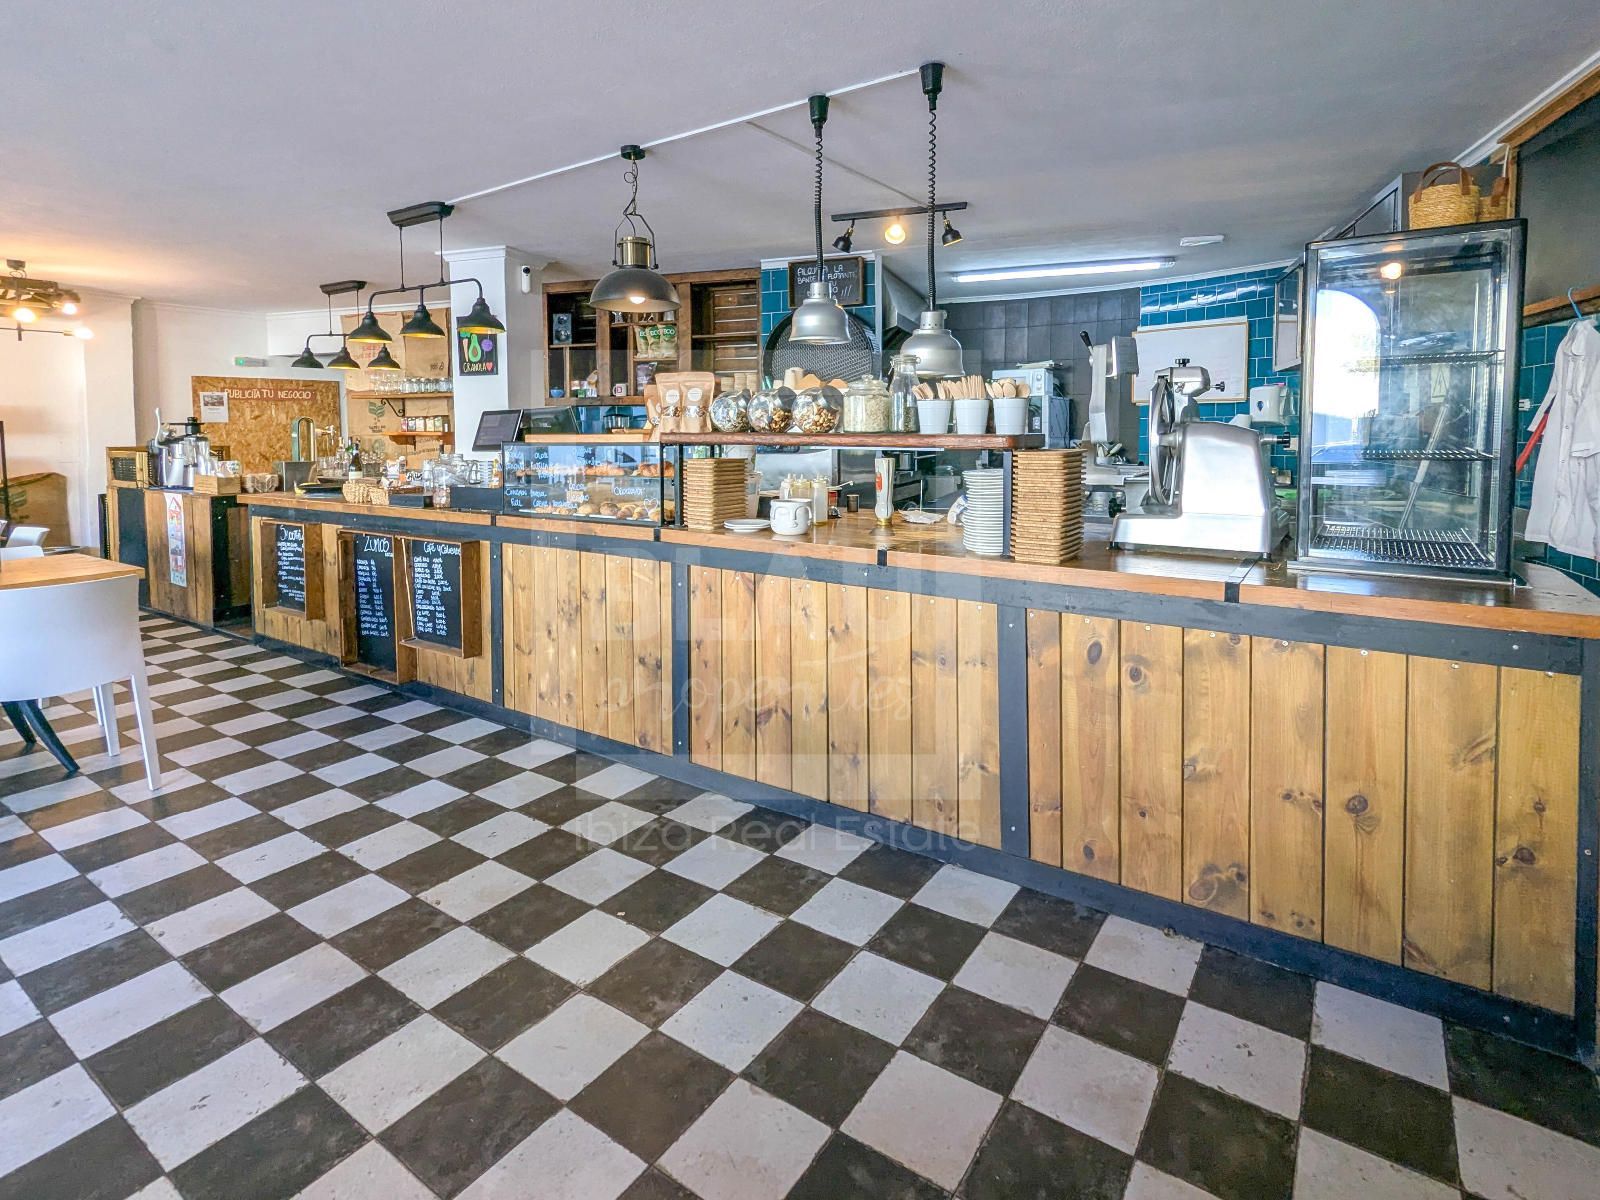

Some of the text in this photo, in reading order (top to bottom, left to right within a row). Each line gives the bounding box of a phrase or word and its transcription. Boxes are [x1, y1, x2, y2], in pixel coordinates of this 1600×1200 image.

[833, 264, 843, 272] LA
[262, 388, 274, 398] TU
[278, 390, 312, 399] NEGOCIO
